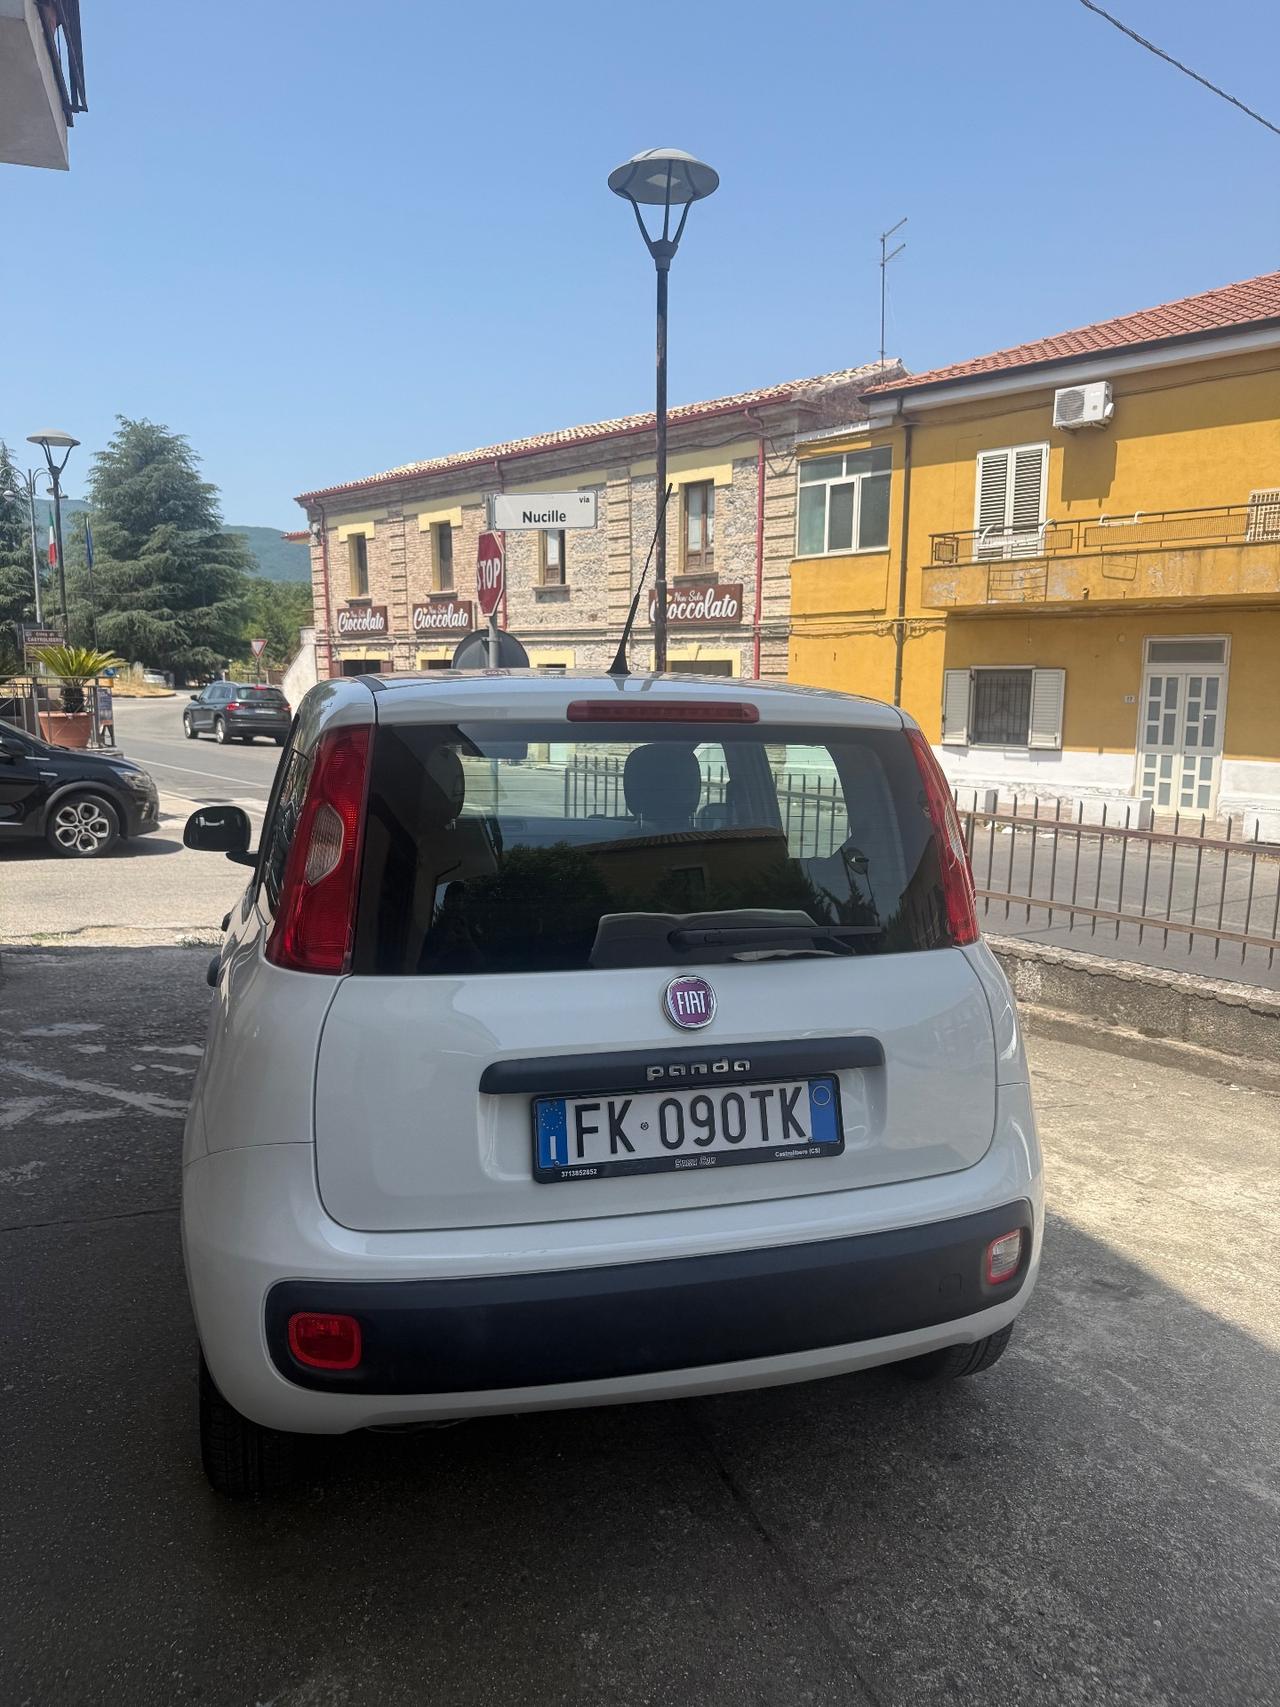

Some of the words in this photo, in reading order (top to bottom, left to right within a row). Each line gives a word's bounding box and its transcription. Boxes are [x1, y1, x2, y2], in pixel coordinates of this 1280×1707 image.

[579, 496, 590, 504] via
[522, 510, 567, 524] Nucille
[413, 603, 469, 630] Cioccolato
[649, 588, 738, 622] occolato
[338, 608, 385, 633] Cioccolato
[676, 990, 706, 1015] FIAT
[646, 1057, 751, 1081] panda
